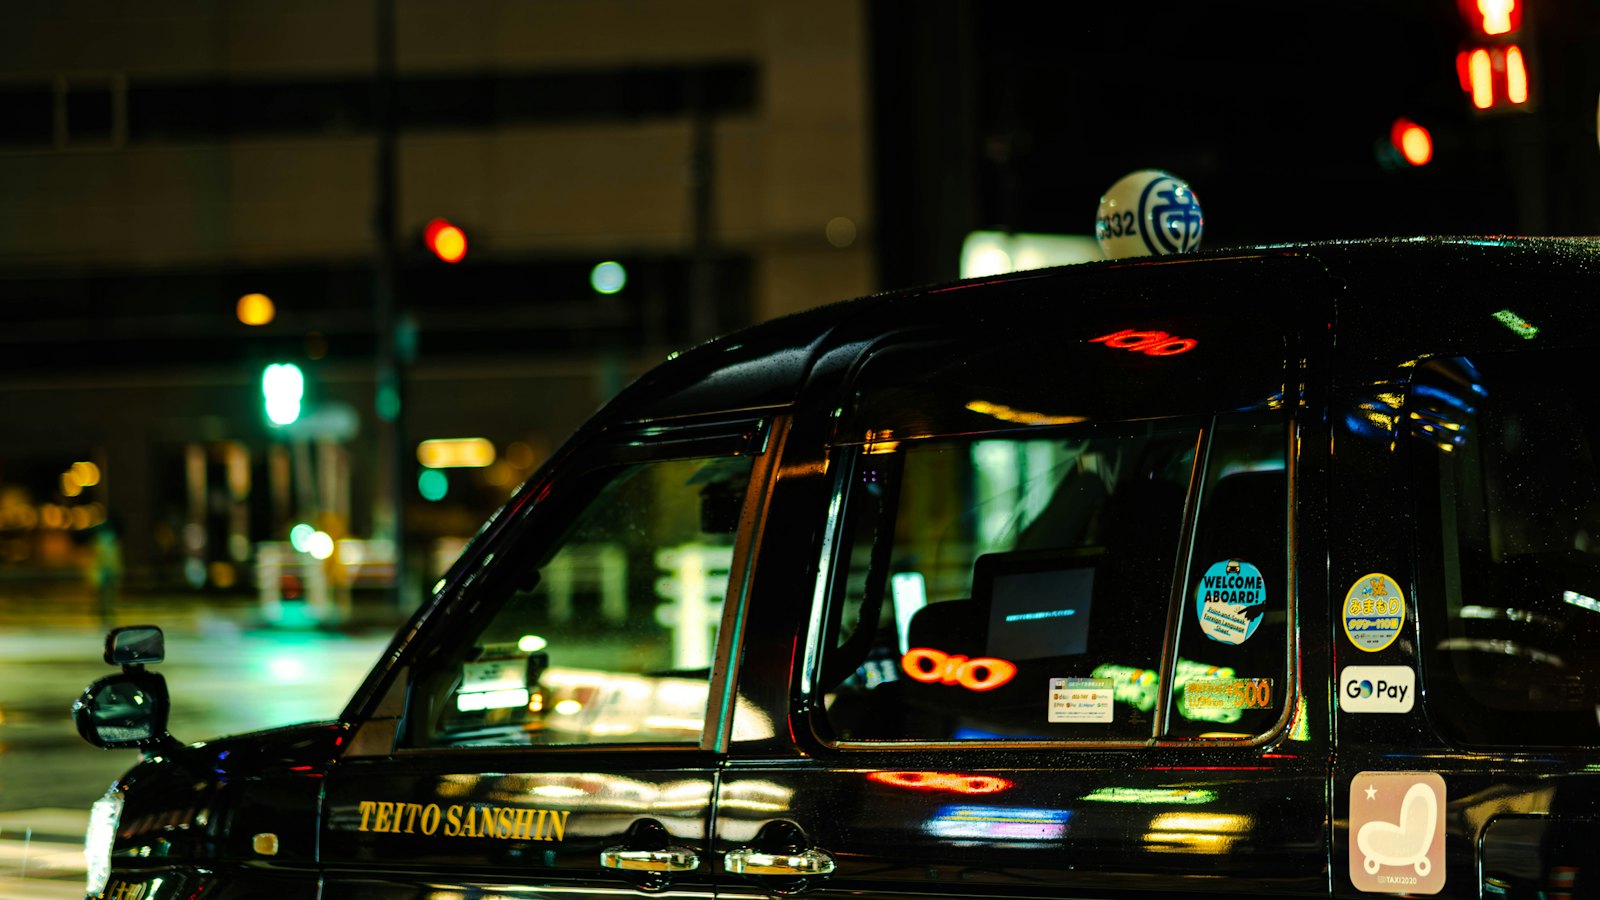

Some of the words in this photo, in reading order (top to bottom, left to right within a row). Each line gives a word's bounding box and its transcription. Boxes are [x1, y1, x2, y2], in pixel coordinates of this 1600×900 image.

[1203, 576, 1263, 589] WELCOME
[1204, 590, 1260, 604] ABOARD!
[1349, 597, 1400, 615] みまもり
[1346, 680, 1374, 698] GO
[1377, 680, 1408, 703] Pay
[358, 801, 441, 836] TEITO
[444, 805, 571, 842] SANSHIN
